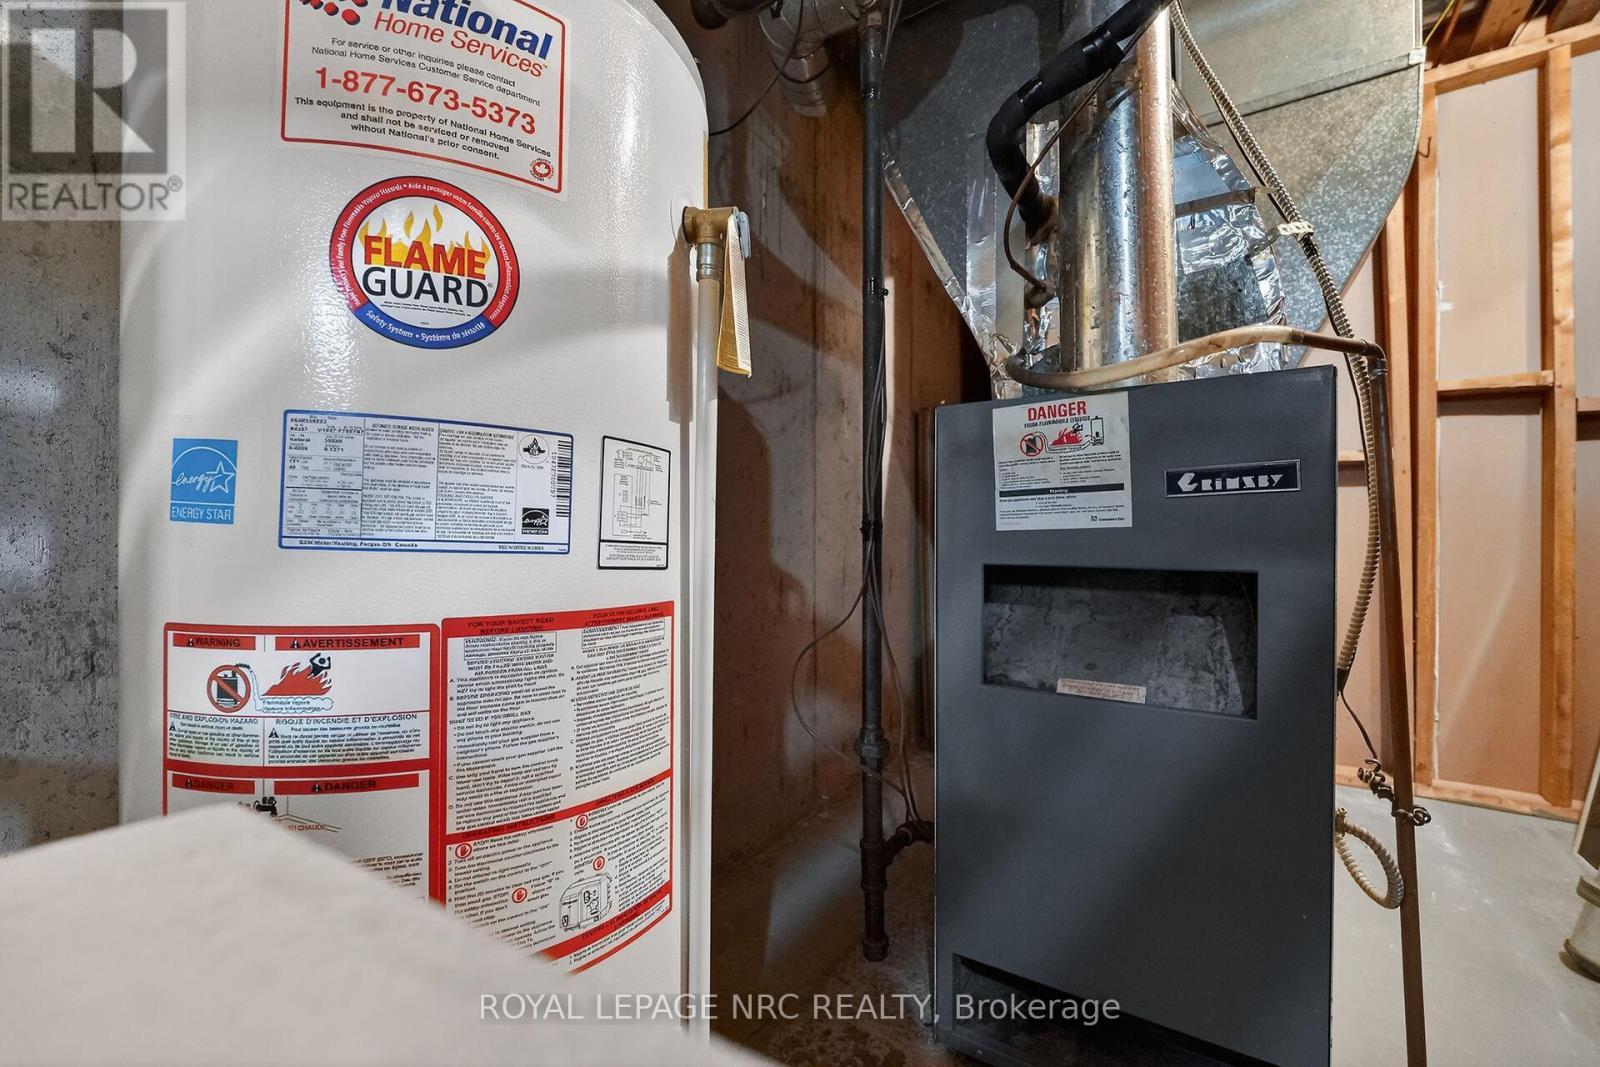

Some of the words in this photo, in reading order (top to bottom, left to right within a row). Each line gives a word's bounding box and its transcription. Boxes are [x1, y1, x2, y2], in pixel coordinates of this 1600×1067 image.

[374, 11, 445, 43] Home
[312, 46, 347, 57] National
[350, 51, 375, 61] Home
[378, 54, 416, 69] Services
[418, 62, 460, 79] Customer
[463, 73, 494, 90] Service
[496, 84, 541, 107] department
[331, 37, 345, 46] For
[348, 40, 379, 51] service
[393, 47, 415, 58] other
[418, 53, 454, 68] inquiries
[457, 63, 484, 77] please
[486, 72, 516, 87] contact
[315, 67, 536, 135] 1-877-673-5373
[294, 97, 314, 106] This
[316, 99, 365, 112] equipment
[368, 103, 376, 112] is
[379, 105, 393, 115] the
[396, 109, 436, 123] property
[438, 117, 448, 126] of
[450, 119, 487, 136] National
[489, 131, 515, 145] Home
[516, 139, 552, 157] Services
[340, 111, 359, 121] and
[361, 114, 384, 124] shall
[386, 117, 402, 127] not
[403, 119, 416, 129] be
[418, 125, 458, 139] serviced
[459, 133, 471, 141] or
[471, 136, 510, 153] removed
[350, 124, 386, 135] without
[388, 128, 435, 143] National's
[437, 138, 460, 149] prior
[461, 144, 500, 160] consent.
[364, 235, 486, 281] FLAME
[366, 309, 388, 328] Safety
[386, 323, 413, 339] System
[1027, 400, 1087, 421] DANGER
[171, 505, 205, 519] ENERGY
[206, 508, 232, 521] STAR
[196, 638, 241, 648] WARNING
[303, 637, 404, 649] AVERTISSEMENT
[193, 780, 235, 791] DANGER
[324, 780, 377, 791] DANGER
